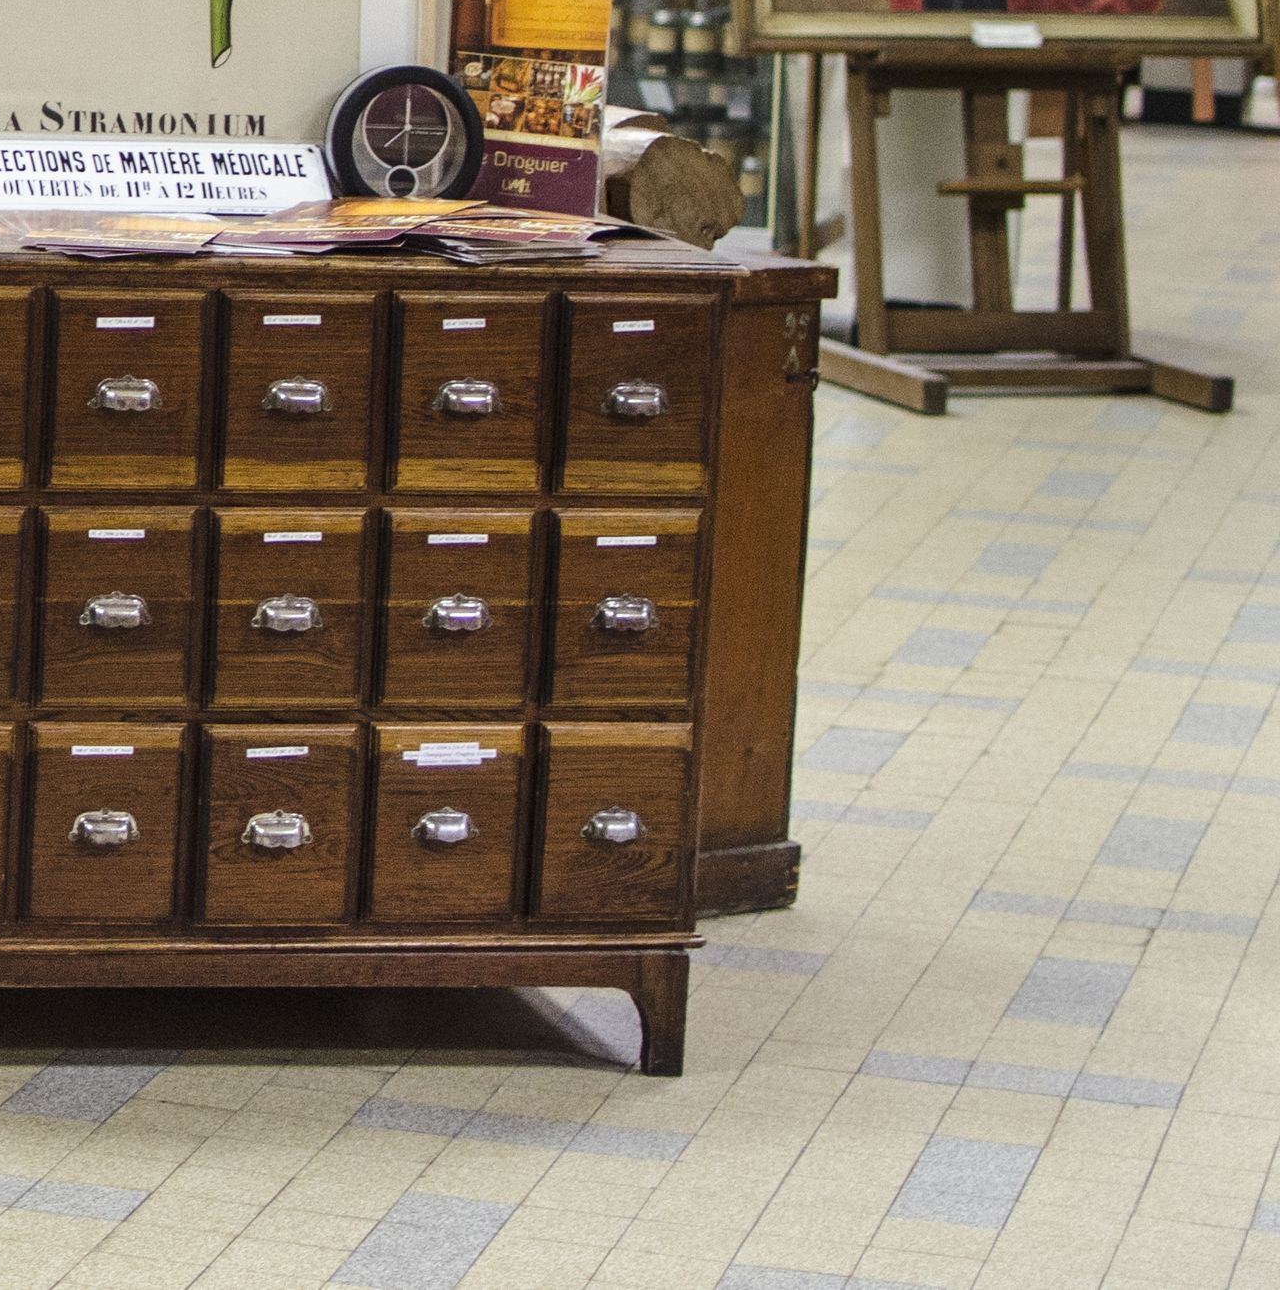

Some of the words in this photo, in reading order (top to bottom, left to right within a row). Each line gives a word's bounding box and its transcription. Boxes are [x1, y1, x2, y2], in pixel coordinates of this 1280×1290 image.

[40, 101, 267, 137] STRAMONIUM
[92, 154, 115, 174] DE
[121, 147, 205, 175] MATIÈRE
[212, 149, 307, 178] MÉDICALE
[494, 151, 568, 174] Droguier
[2, 179, 92, 198] OUVERTES
[99, 184, 120, 198] DE
[176, 181, 195, 199] 12
[202, 182, 268, 201] HEURES
